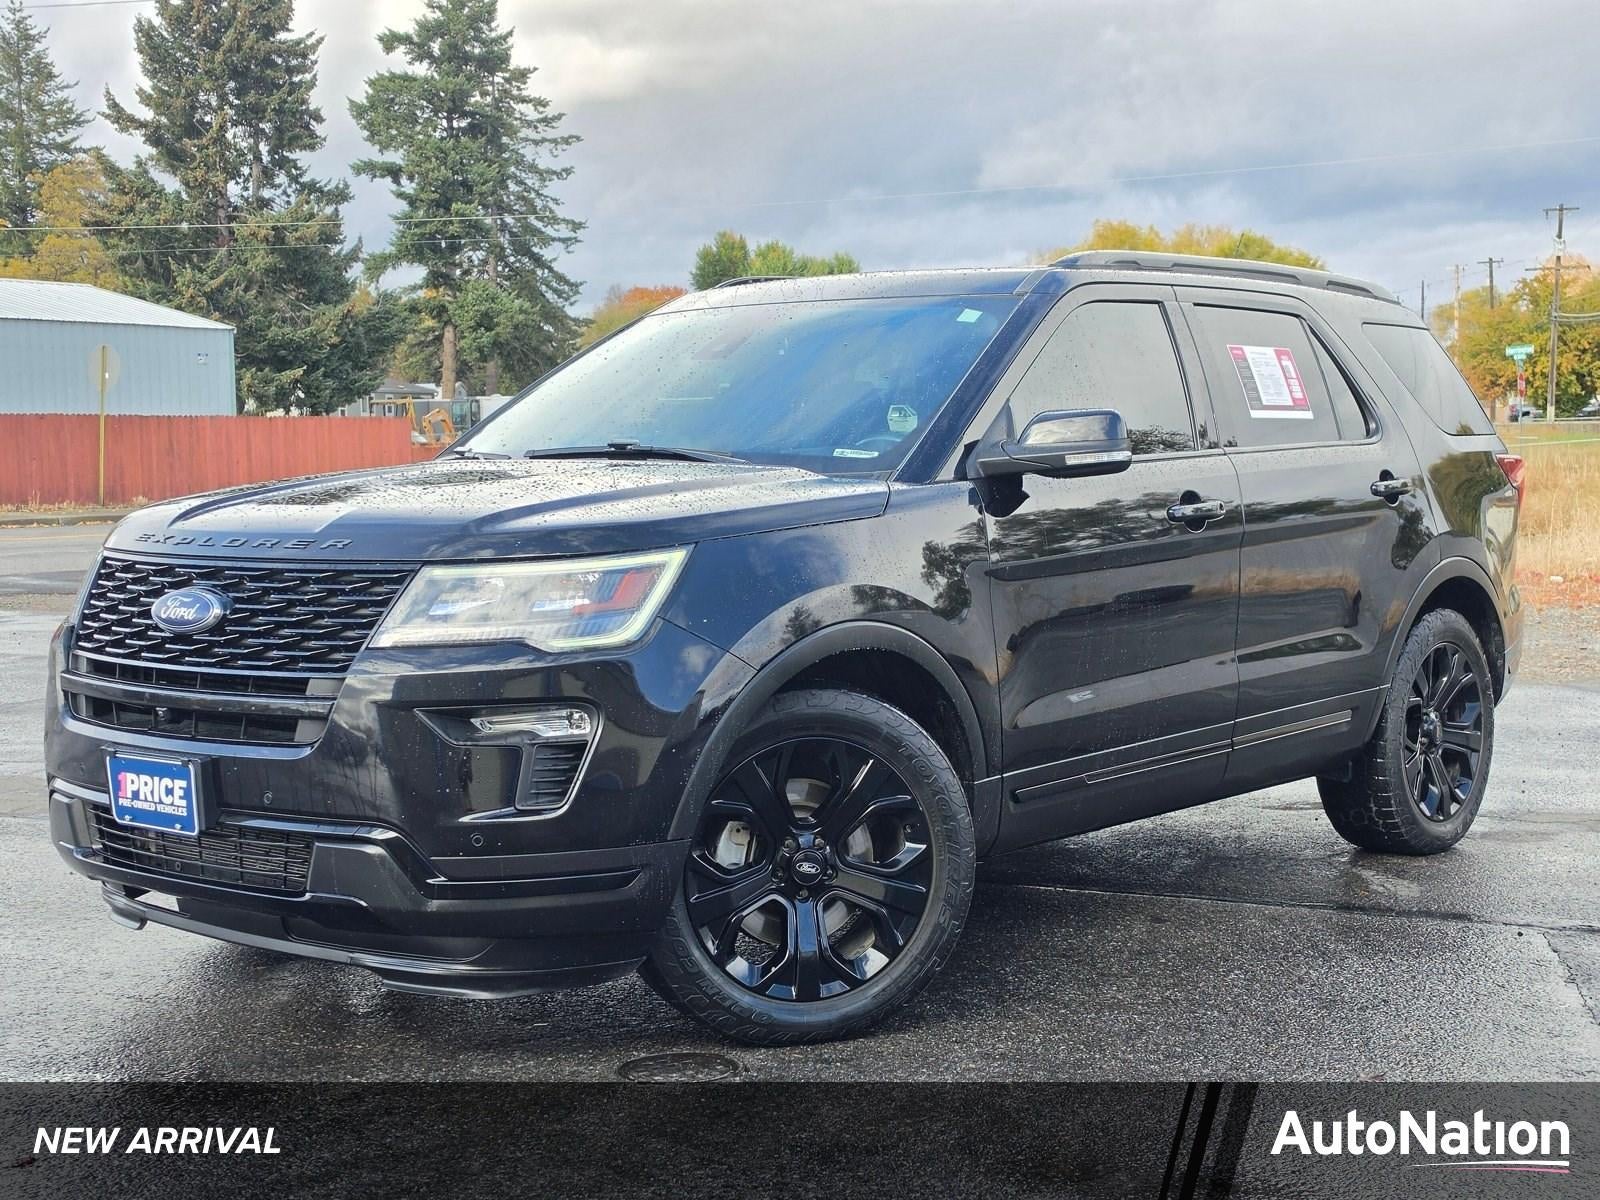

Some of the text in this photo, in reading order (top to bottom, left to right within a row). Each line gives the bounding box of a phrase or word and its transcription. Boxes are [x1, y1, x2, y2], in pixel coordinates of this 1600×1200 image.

[135, 533, 352, 549] EXPLORER
[161, 596, 200, 620] Ford
[117, 772, 187, 807] 1PRICE
[118, 797, 187, 816] PRE-OWNED VEHICLES
